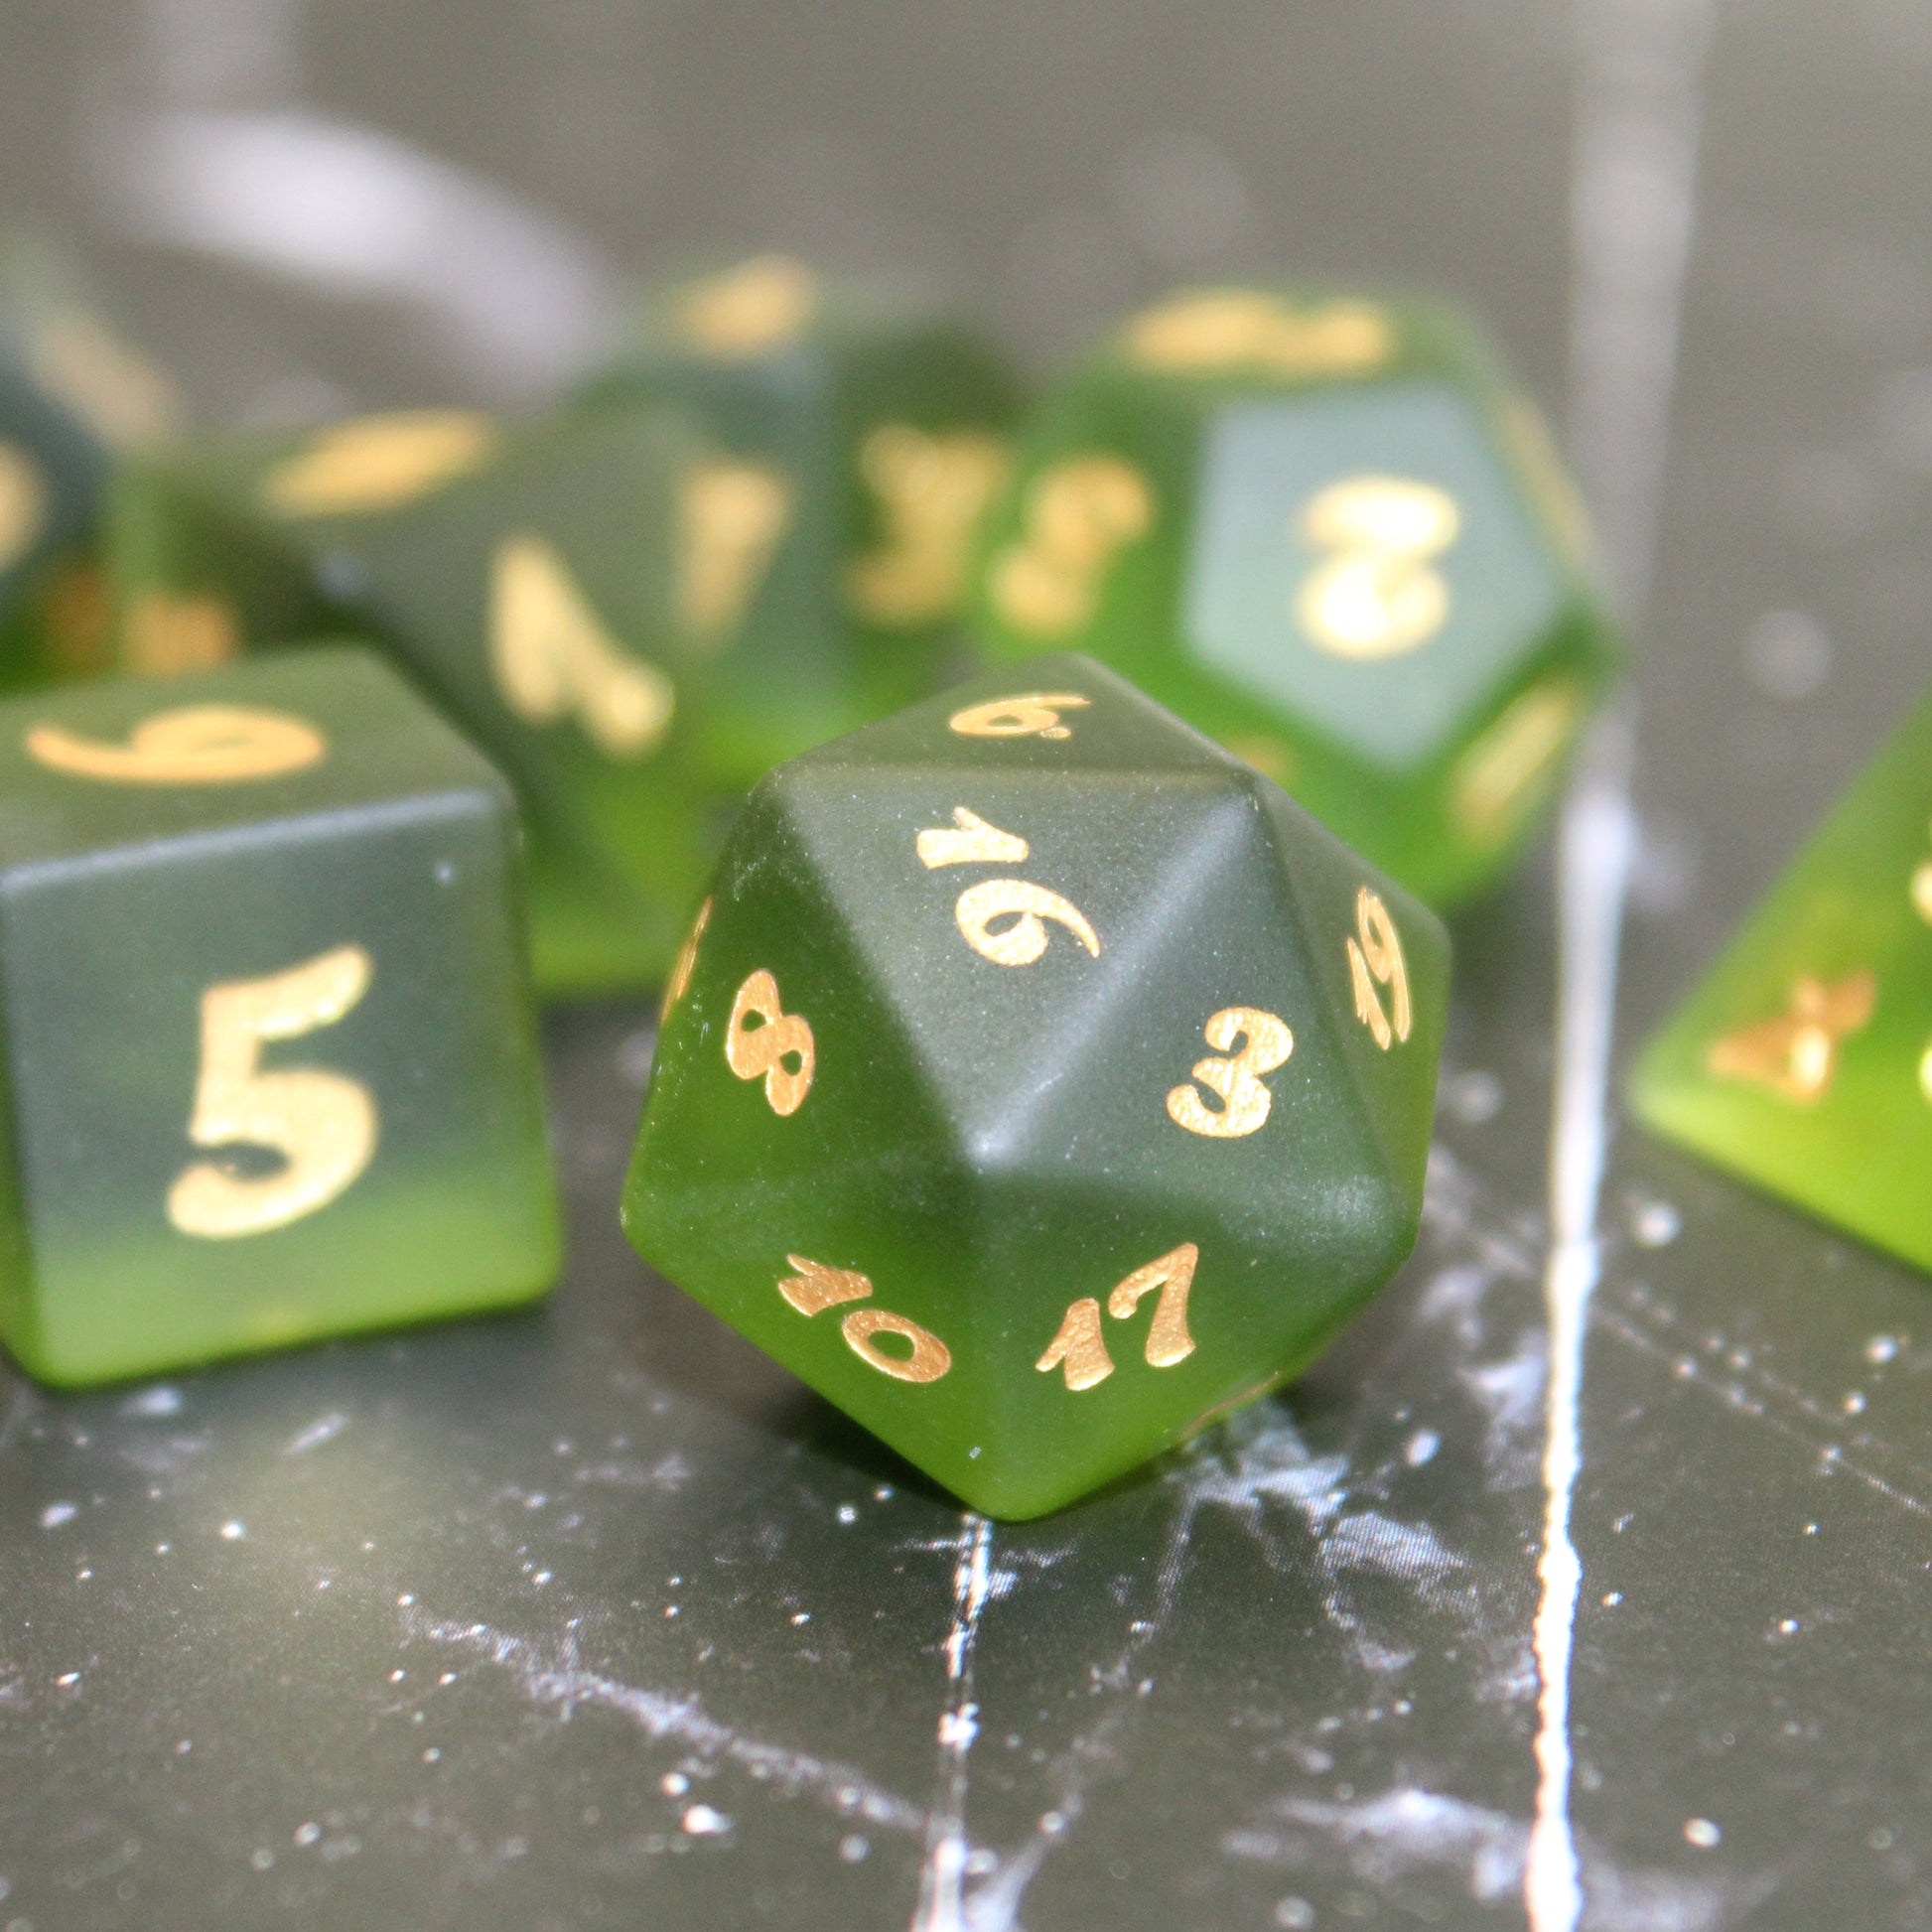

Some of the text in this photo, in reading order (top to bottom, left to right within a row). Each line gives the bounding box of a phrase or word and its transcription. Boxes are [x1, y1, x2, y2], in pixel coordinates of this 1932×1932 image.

[26, 707, 326, 784] 6
[916, 805, 1103, 968] 16
[1347, 887, 1413, 1050] 19
[167, 943, 378, 1241] 5
[726, 970, 816, 1118] 8
[1167, 1008, 1295, 1140] 3
[778, 1254, 952, 1384] 10
[1035, 1243, 1200, 1392] 17
